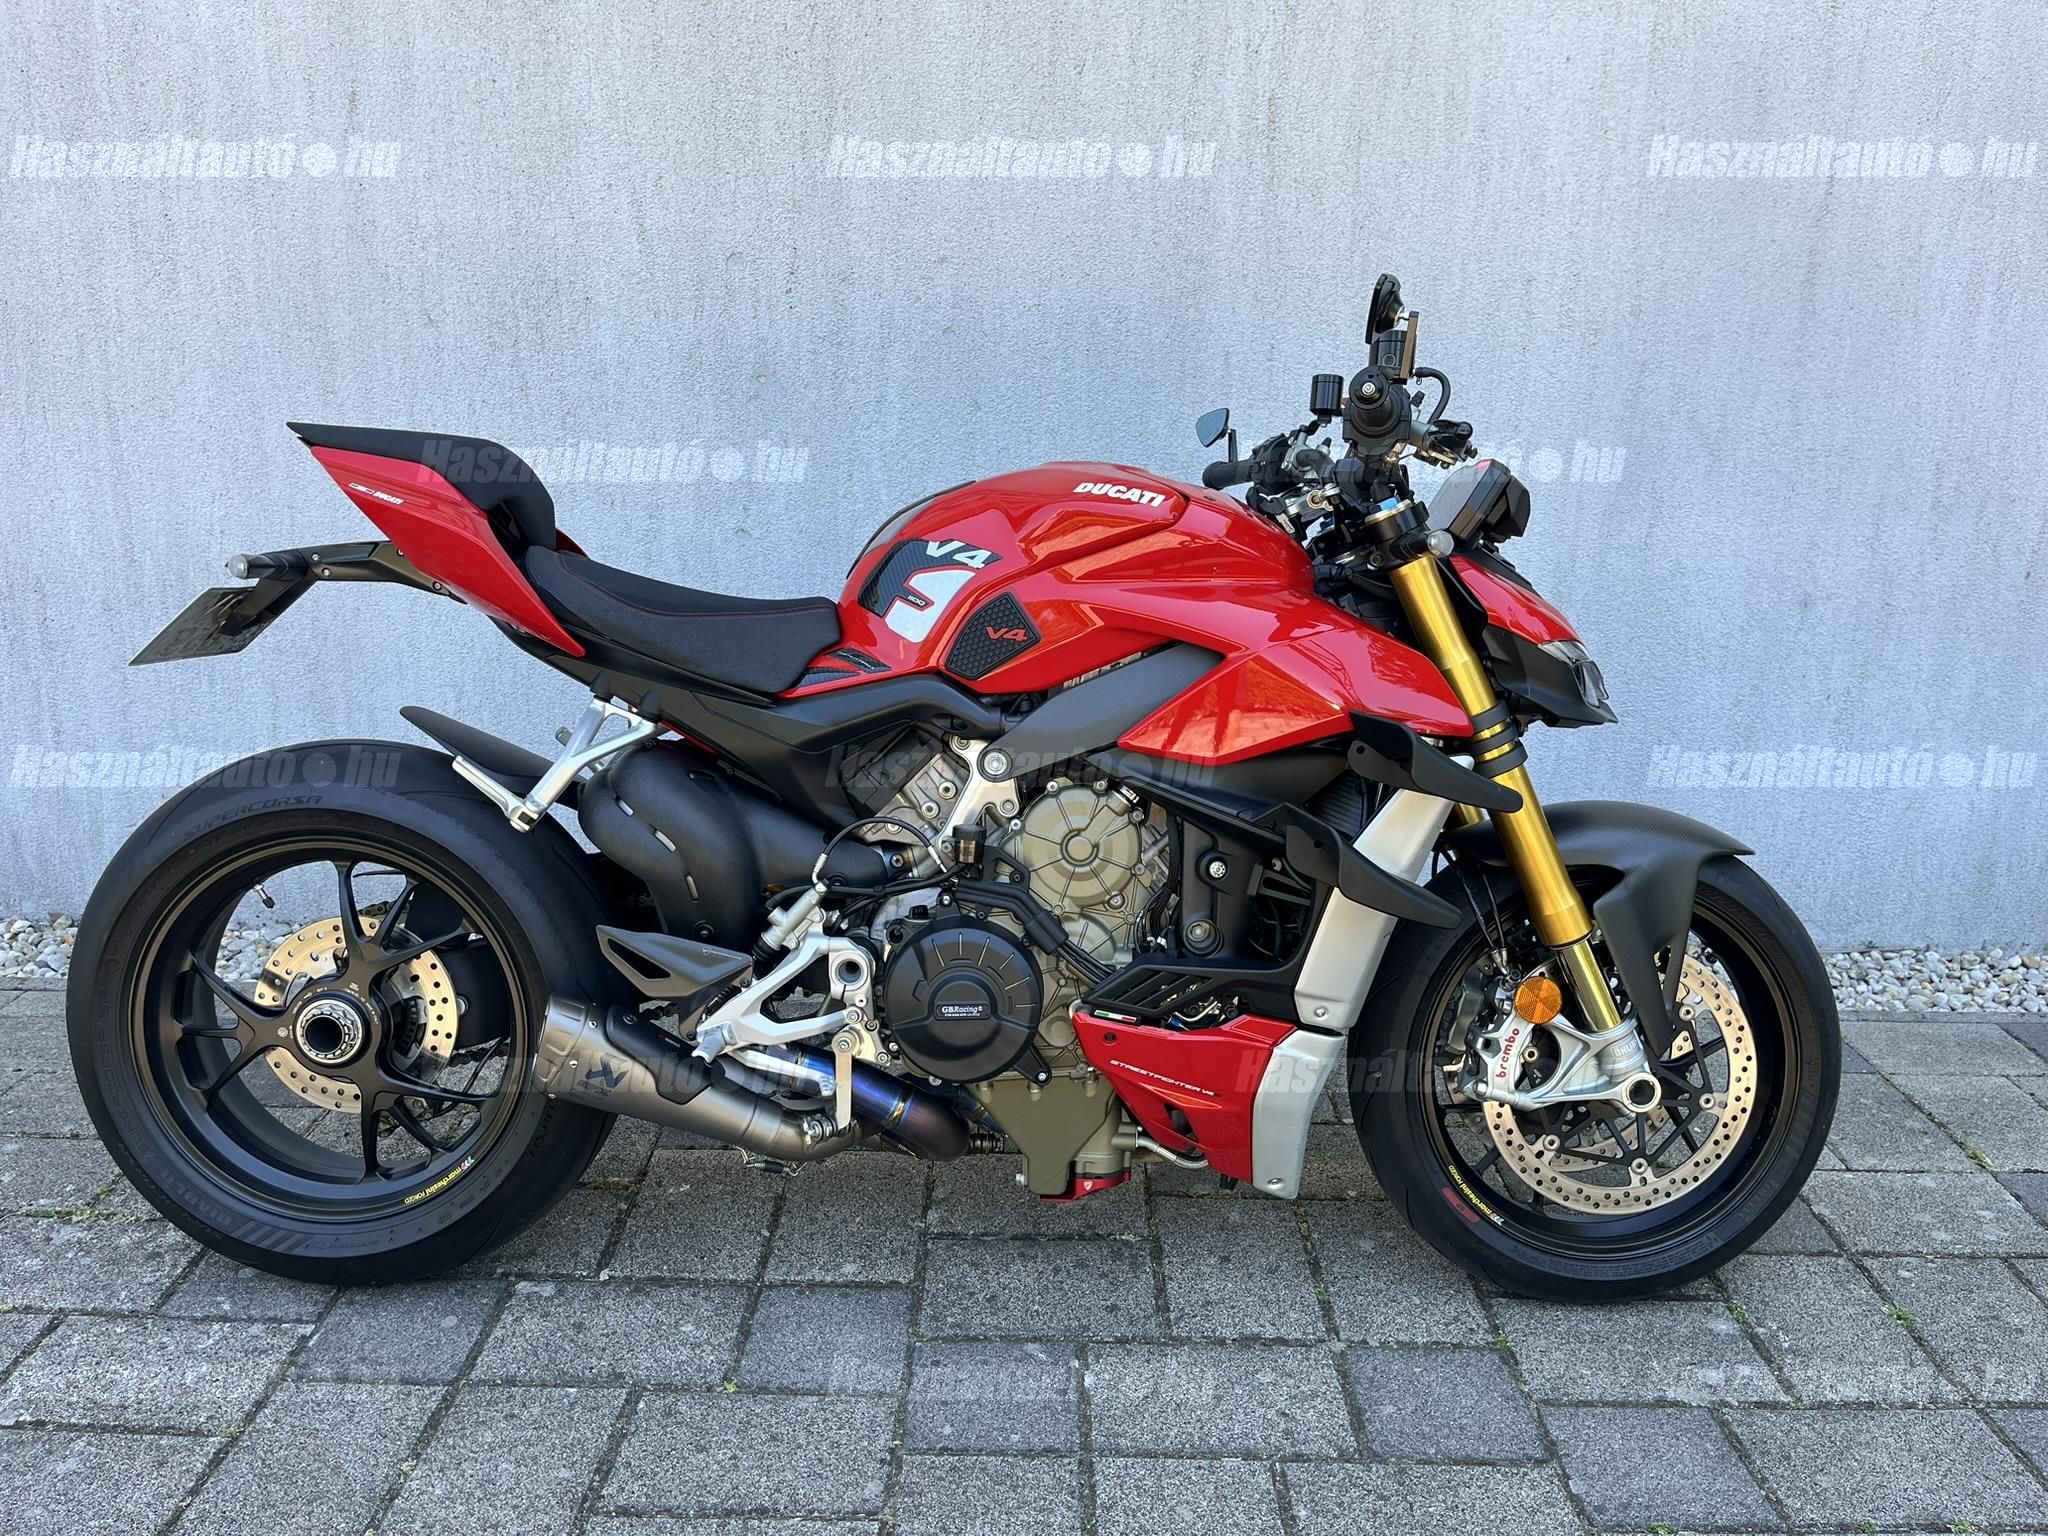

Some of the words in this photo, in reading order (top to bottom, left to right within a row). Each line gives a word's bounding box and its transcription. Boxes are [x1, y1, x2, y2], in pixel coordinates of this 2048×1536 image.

[373, 491, 404, 505] DUCATI
[1073, 482, 1166, 508] DUCATI
[925, 540, 993, 569] V4
[986, 626, 1028, 642] V4
[1495, 1027, 1521, 1079] brembo
